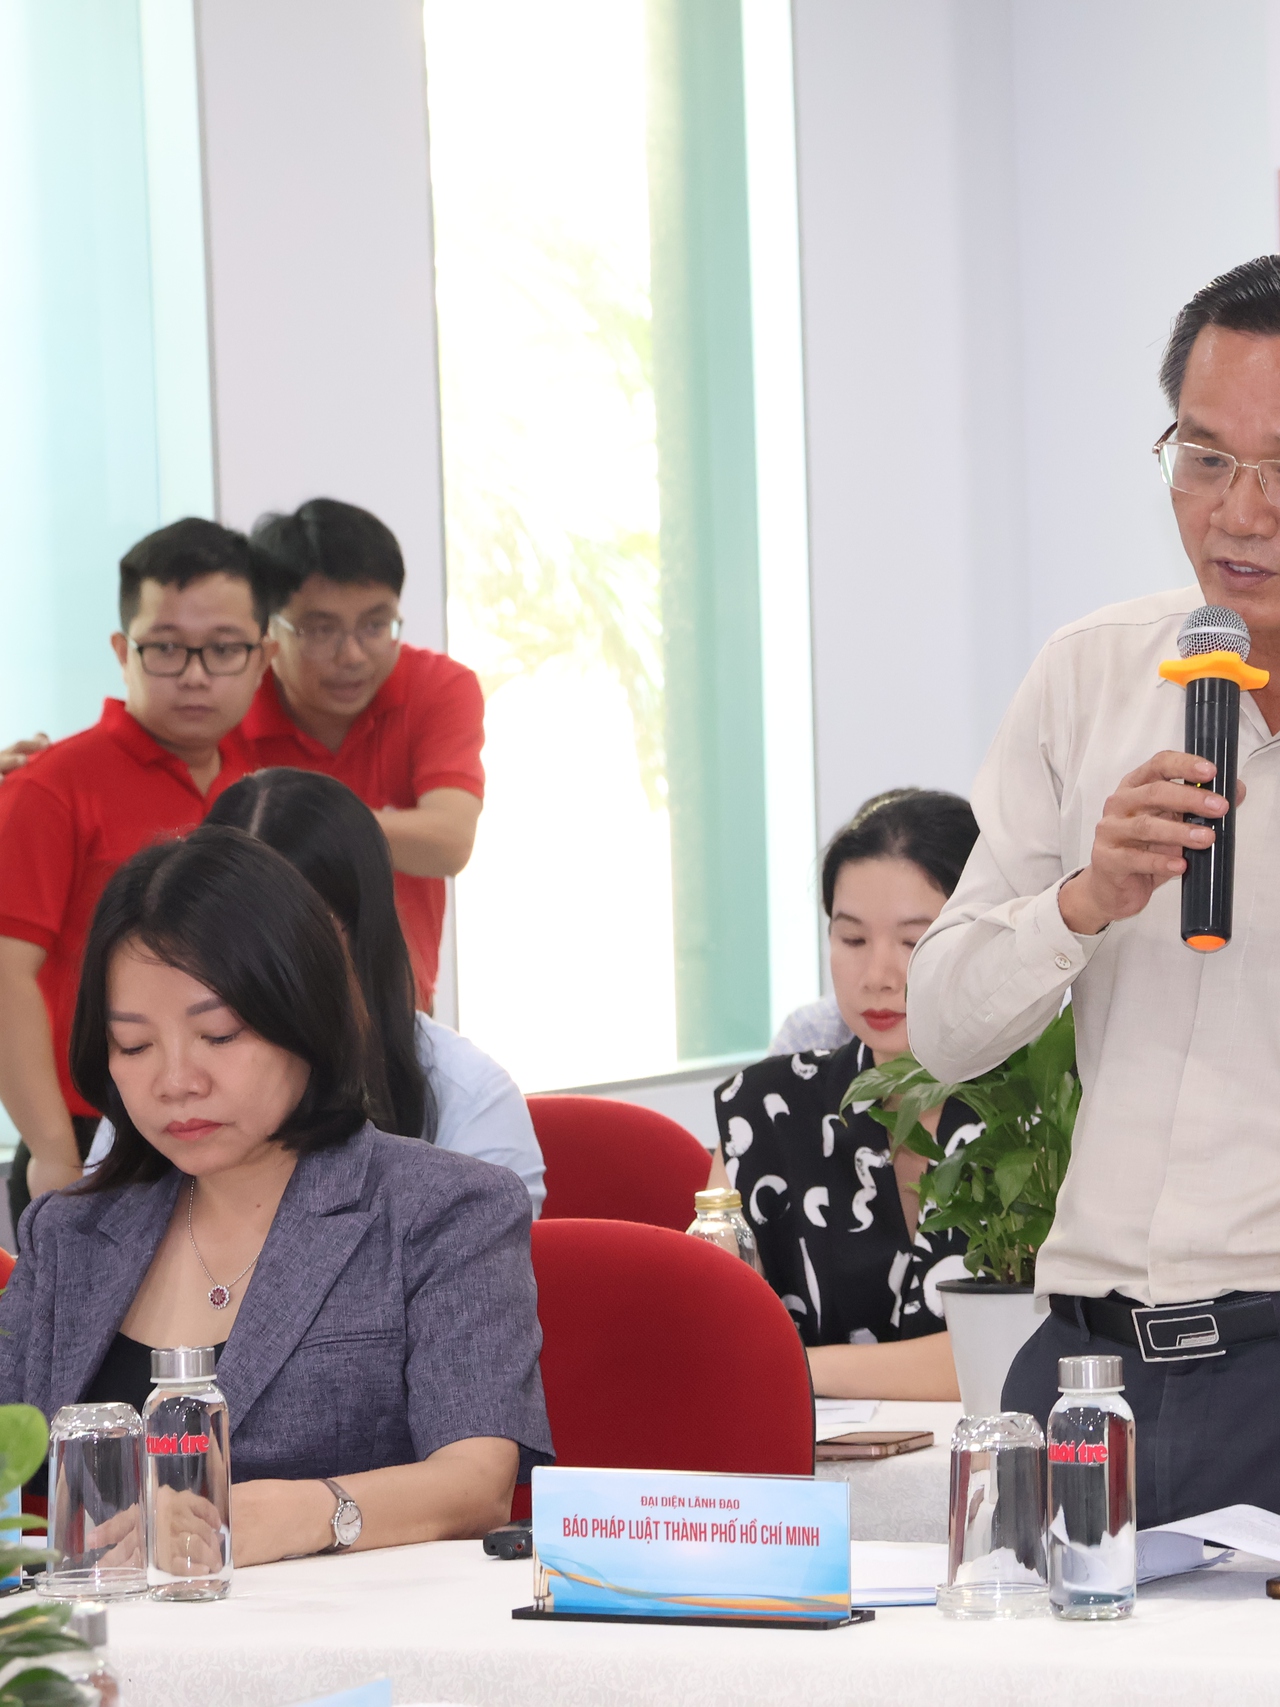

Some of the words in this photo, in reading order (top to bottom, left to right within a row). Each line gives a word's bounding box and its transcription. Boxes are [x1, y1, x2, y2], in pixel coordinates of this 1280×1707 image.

[640, 1496, 658, 1509] ĐẠI
[661, 1495, 686, 1510] DIỆN
[688, 1496, 716, 1509] LÃNH
[719, 1499, 740, 1512] ĐẠO
[562, 1513, 588, 1538] BÁO
[592, 1515, 625, 1539] PHÁP
[629, 1516, 660, 1544] LUẬT
[664, 1517, 707, 1542] THÀNH
[711, 1517, 738, 1544] PHỐ
[740, 1518, 758, 1545] HỒ
[761, 1521, 783, 1546] CHÍ
[786, 1525, 820, 1547] MINH
